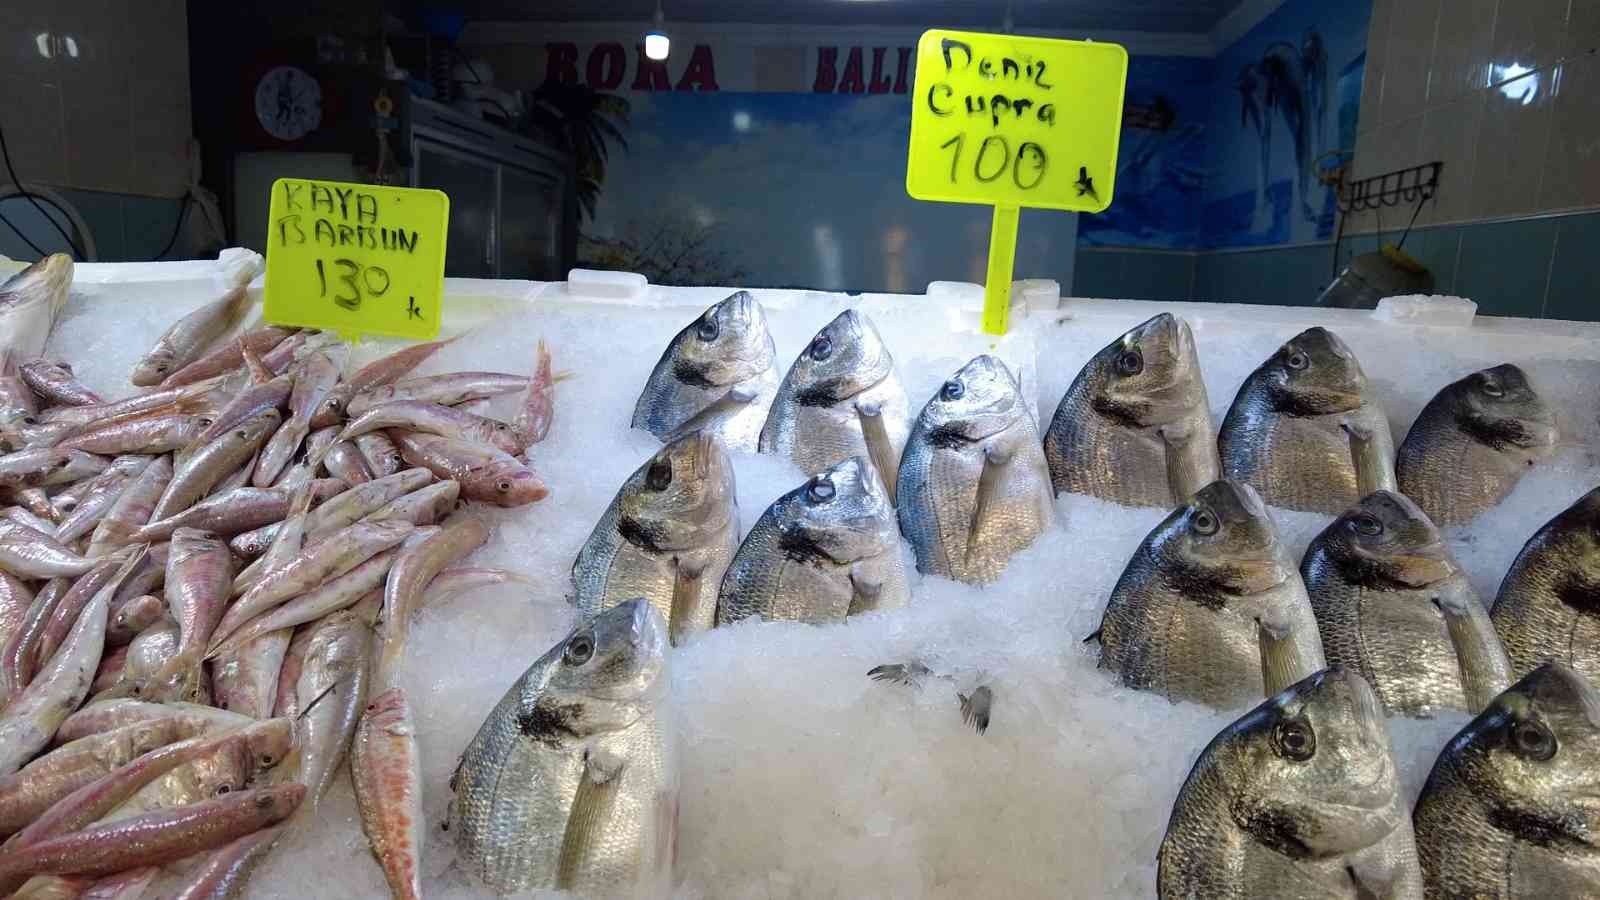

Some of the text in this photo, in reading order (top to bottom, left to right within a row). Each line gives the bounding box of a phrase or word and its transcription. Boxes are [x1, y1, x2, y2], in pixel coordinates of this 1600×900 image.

[940, 132, 1046, 190] 100
[284, 183, 377, 224] KAYA
[316, 258, 390, 312] 130
